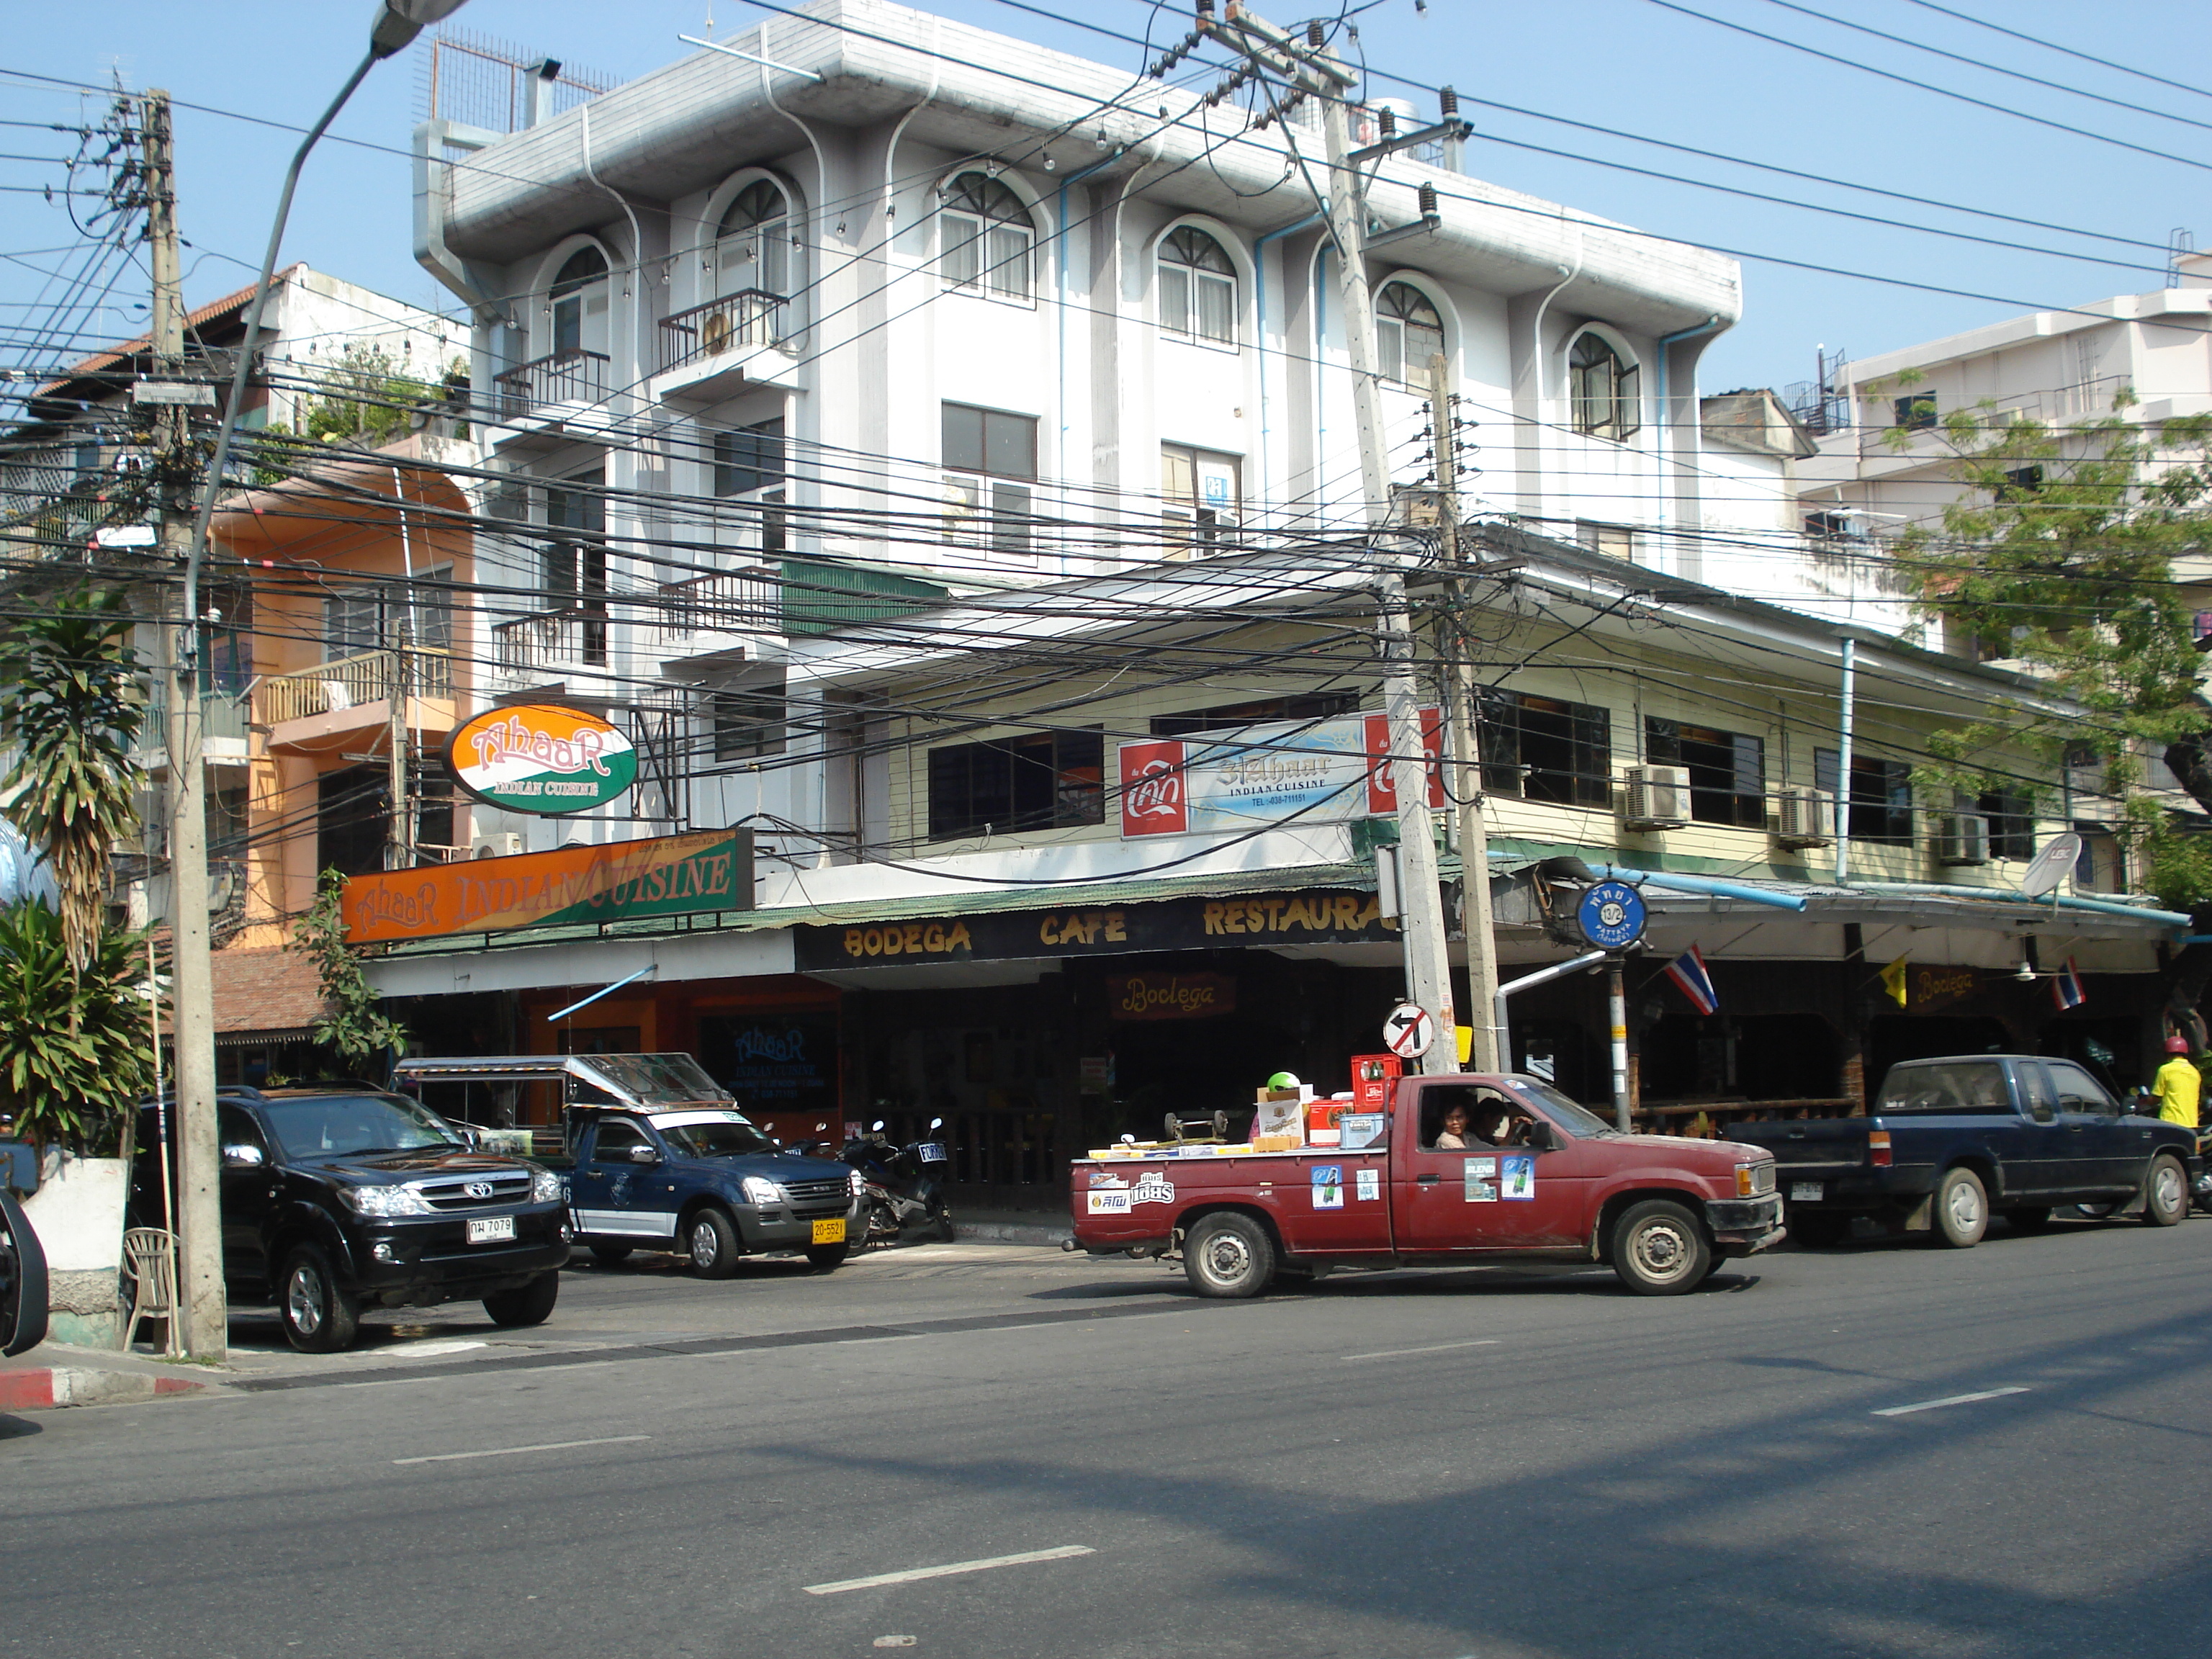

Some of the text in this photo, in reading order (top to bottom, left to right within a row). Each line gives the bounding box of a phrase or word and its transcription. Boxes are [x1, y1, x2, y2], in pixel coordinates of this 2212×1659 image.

[494, 781, 598, 796] INDIAN CUISINE
[1231, 779, 1326, 796] INDIAN CUISINE
[1252, 798, 1264, 806] TEL
[453, 871, 580, 925] INDIAN
[587, 852, 730, 907] CUISINE
[1589, 890, 1633, 907] พัทยา
[1603, 908, 1621, 920] 13/2
[843, 922, 972, 957] BODEGA
[1040, 912, 1127, 945] CAFE
[1595, 923, 1631, 935] PATTAYA
[1917, 970, 1973, 1003] Bodega
[1122, 977, 1215, 1012] Bodega
[736, 1064, 815, 1077] INDIAN CUISINE
[488, 1219, 511, 1232] 7079
[815, 1222, 842, 1236] 20-5521
